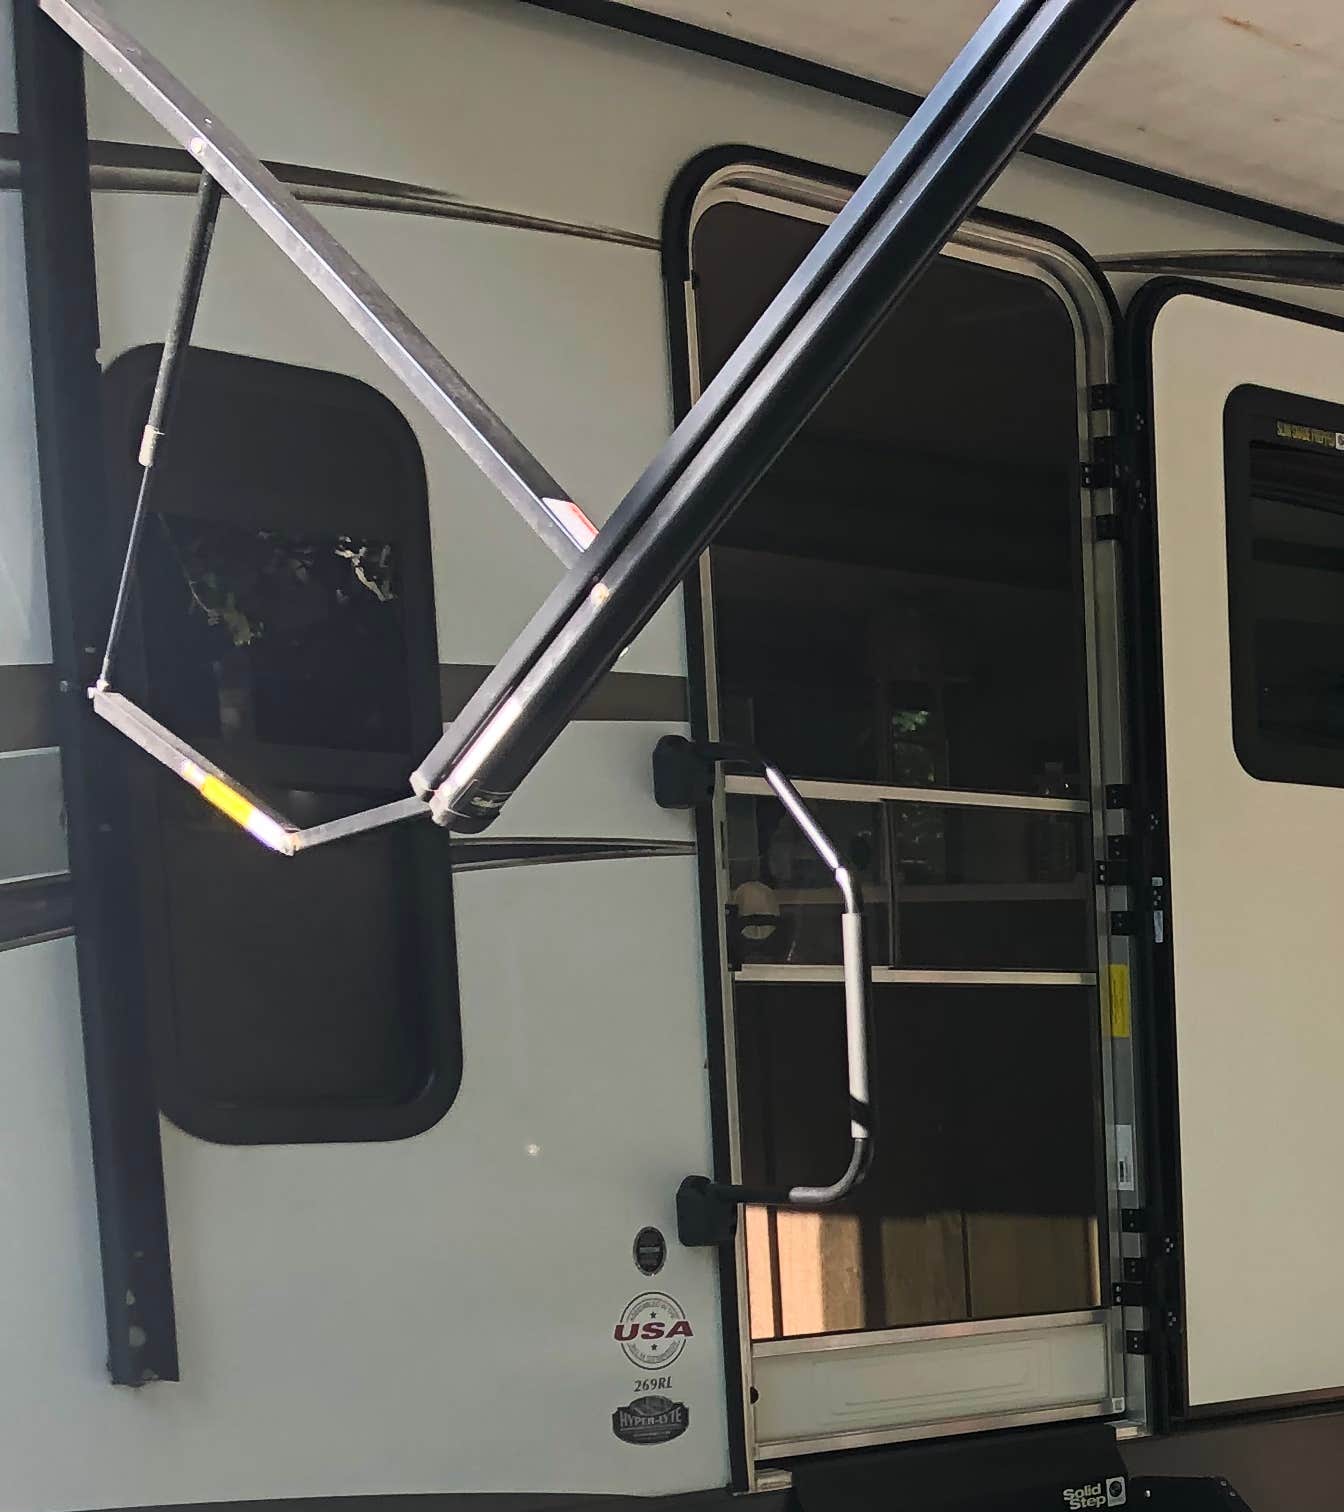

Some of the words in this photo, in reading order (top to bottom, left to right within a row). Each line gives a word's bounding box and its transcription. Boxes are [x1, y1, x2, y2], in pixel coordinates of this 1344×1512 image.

[614, 1320, 694, 1342] USA
[634, 1376, 672, 1392] 269RL
[1063, 1483, 1101, 1502] Solid
[1069, 1494, 1106, 1510] Step
